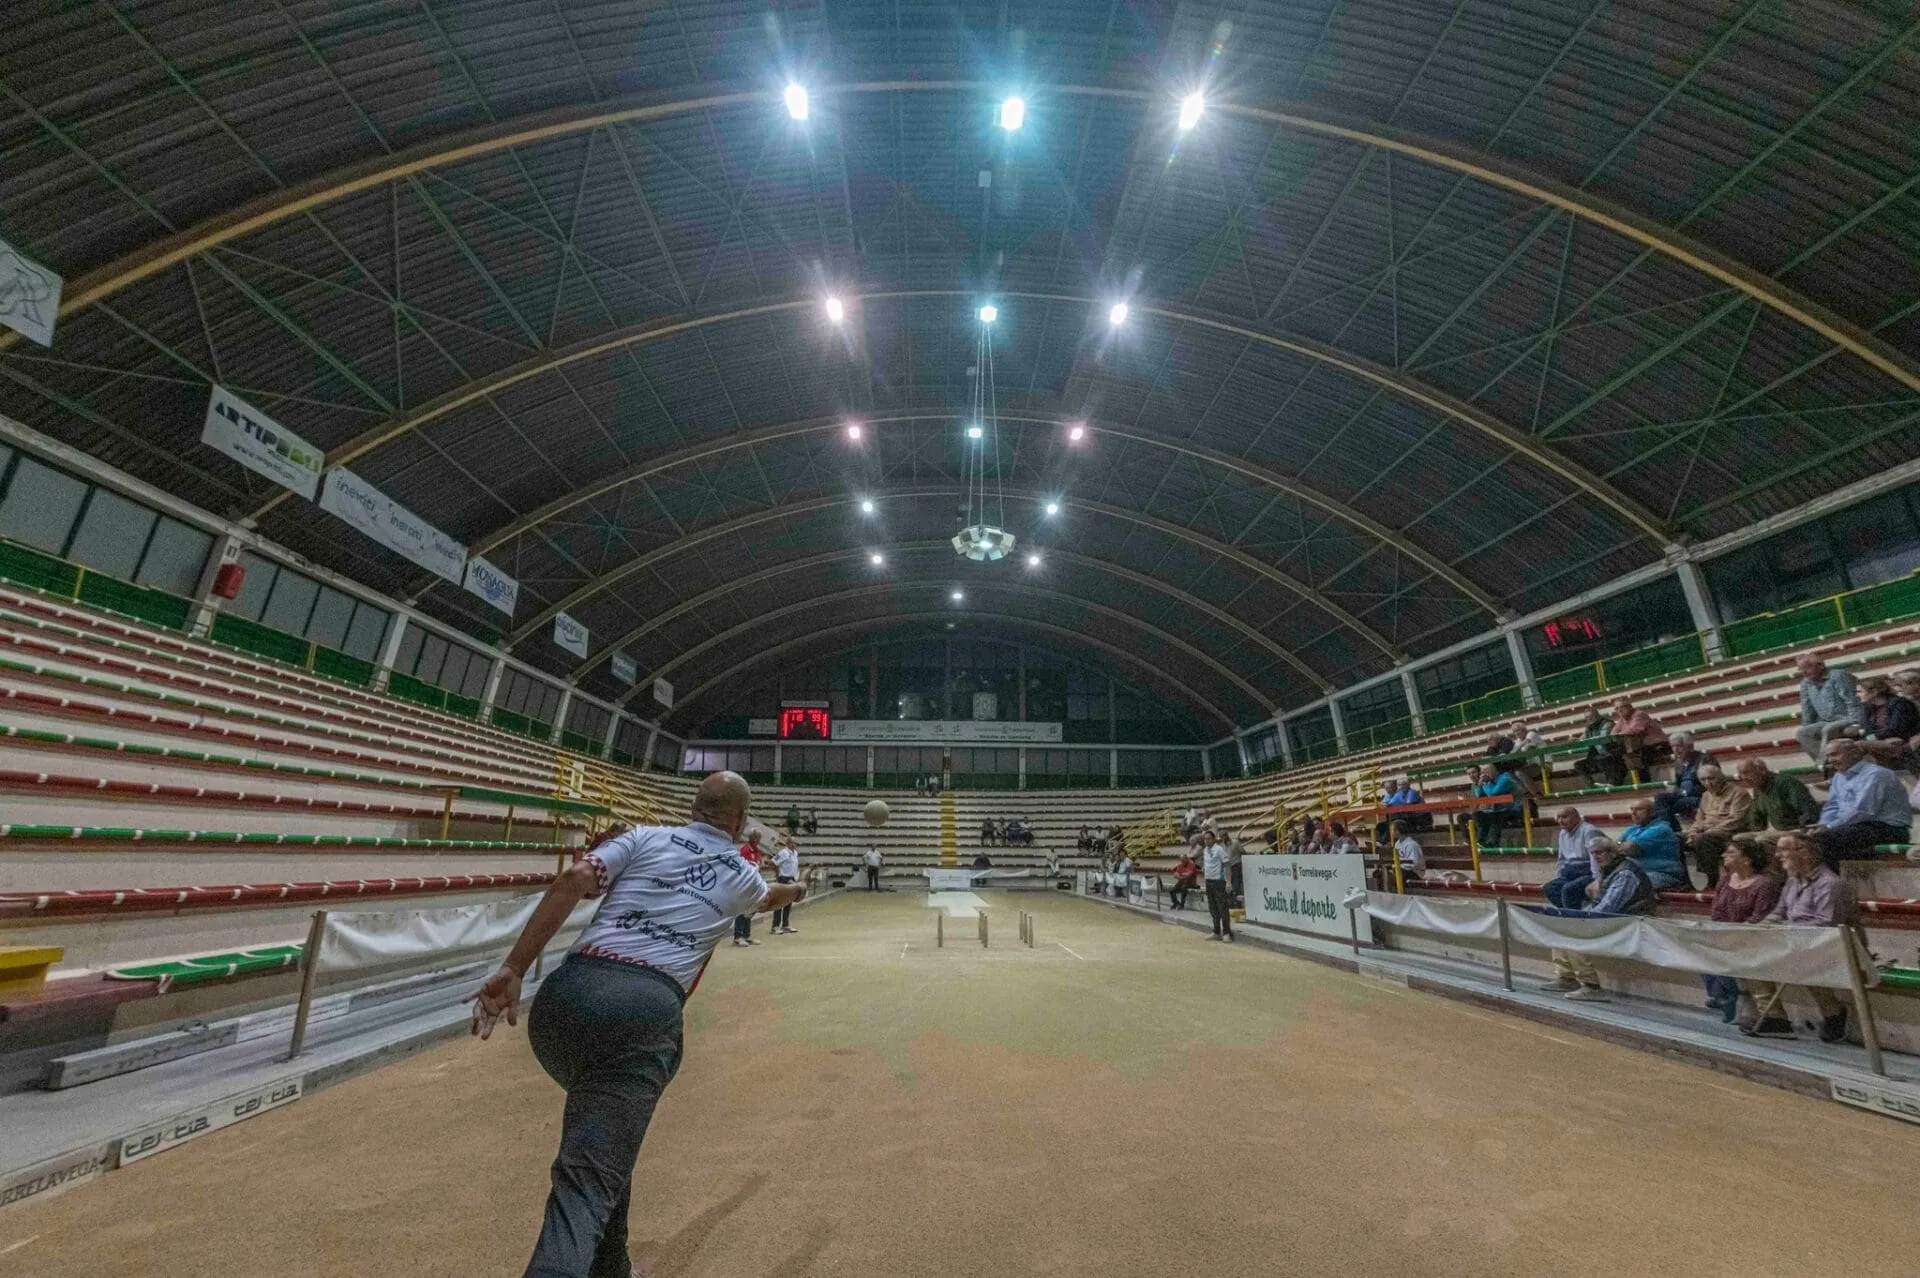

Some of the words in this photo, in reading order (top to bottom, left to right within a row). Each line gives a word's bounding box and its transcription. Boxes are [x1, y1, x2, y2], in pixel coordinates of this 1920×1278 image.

[1262, 887, 1289, 914] Sentir
[1290, 889, 1299, 915] el
[1301, 891, 1338, 923] deporte
